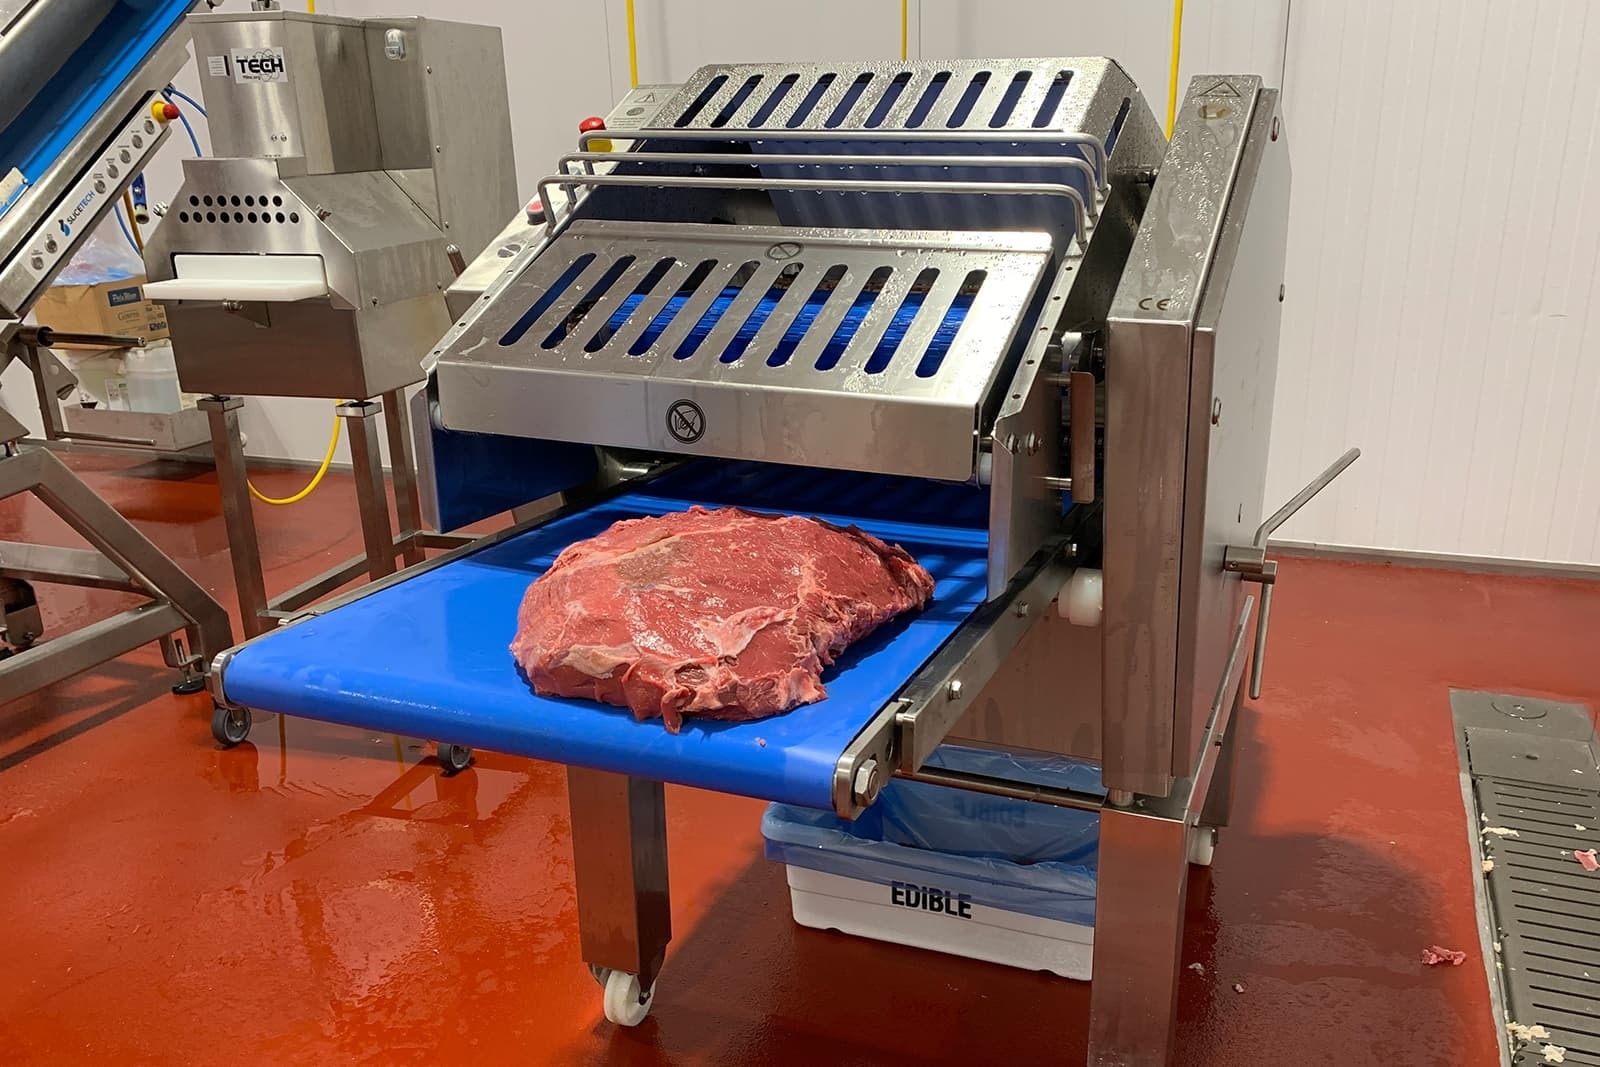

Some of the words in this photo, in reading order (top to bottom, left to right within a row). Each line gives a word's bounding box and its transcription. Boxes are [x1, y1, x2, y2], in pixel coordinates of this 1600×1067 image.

[236, 58, 284, 74] TECH
[67, 191, 95, 225] SLICETECH
[891, 880, 972, 920] EDIBLE
